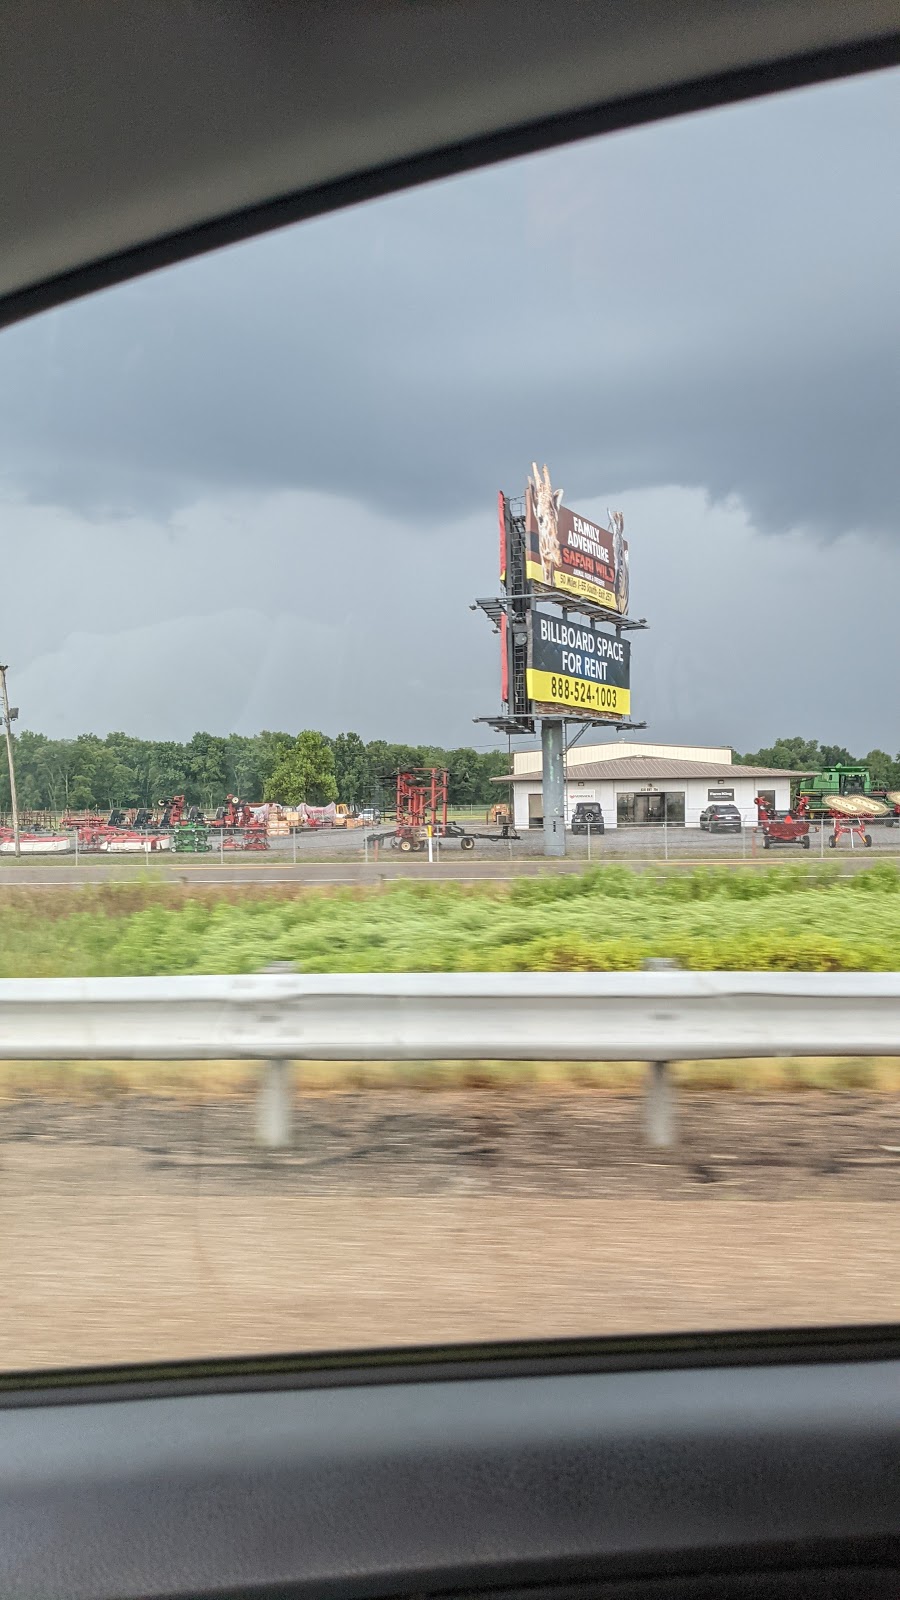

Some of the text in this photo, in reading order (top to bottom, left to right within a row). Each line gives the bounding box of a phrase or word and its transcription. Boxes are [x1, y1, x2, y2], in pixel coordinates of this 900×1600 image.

[573, 516, 600, 543] FAMILY
[568, 530, 610, 563] ADVENTURE
[562, 547, 594, 573] SAFARI
[595, 561, 615, 582] WILD
[560, 574, 566, 585] 50
[567, 576, 577, 588] Miles
[540, 619, 624, 662] BILLBOARD SPACE
[562, 651, 608, 680] FOR RENT
[551, 676, 617, 708] 888-524-1003
